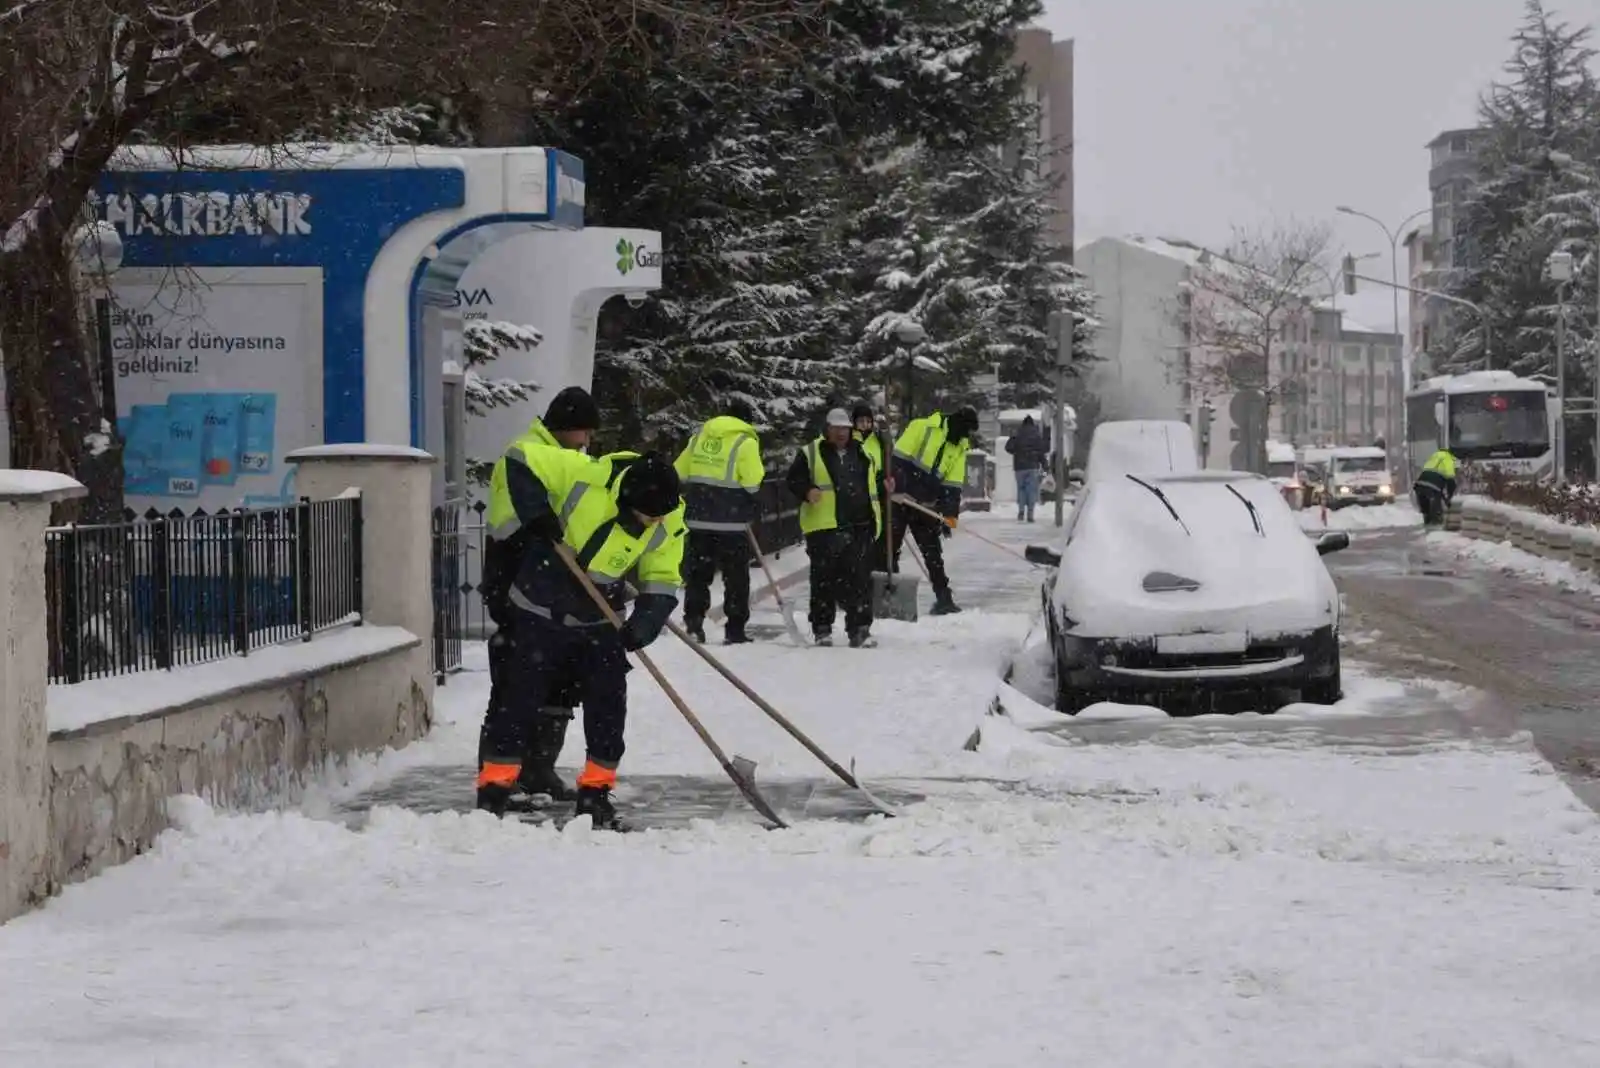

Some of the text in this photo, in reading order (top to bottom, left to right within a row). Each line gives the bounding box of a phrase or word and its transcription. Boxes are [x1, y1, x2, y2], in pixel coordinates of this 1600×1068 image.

[106, 192, 313, 236] HALKBANK
[187, 331, 286, 353] dünyasına
[117, 355, 199, 377] geldiniz!
